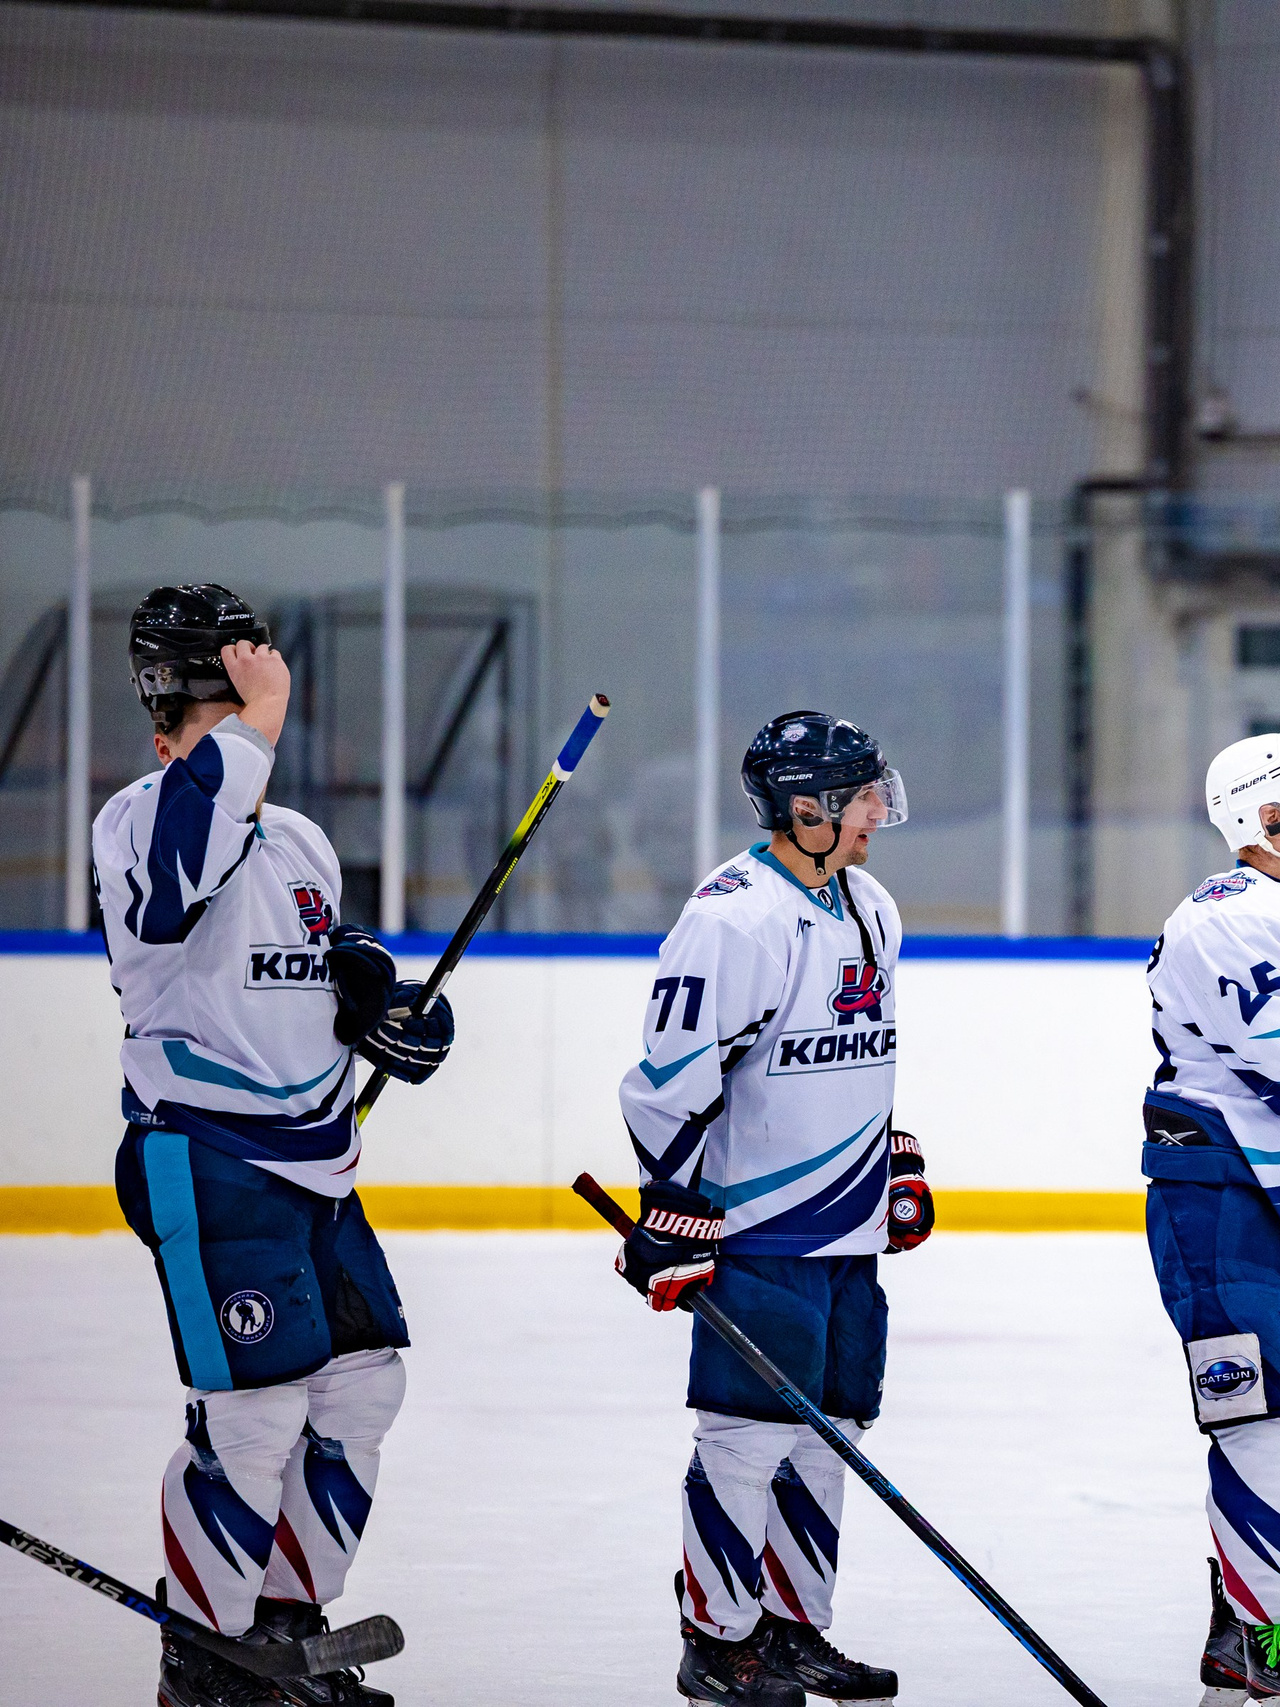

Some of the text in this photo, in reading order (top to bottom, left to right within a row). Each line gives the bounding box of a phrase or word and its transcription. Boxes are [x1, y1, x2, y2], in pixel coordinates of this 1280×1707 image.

[218, 613, 250, 622] EASTON
[777, 773, 814, 782] BAUER
[1230, 773, 1268, 796] BAUER
[651, 975, 707, 1034] 71
[643, 1206, 726, 1241] WARR
[1199, 1370, 1251, 1386] DATSUN
